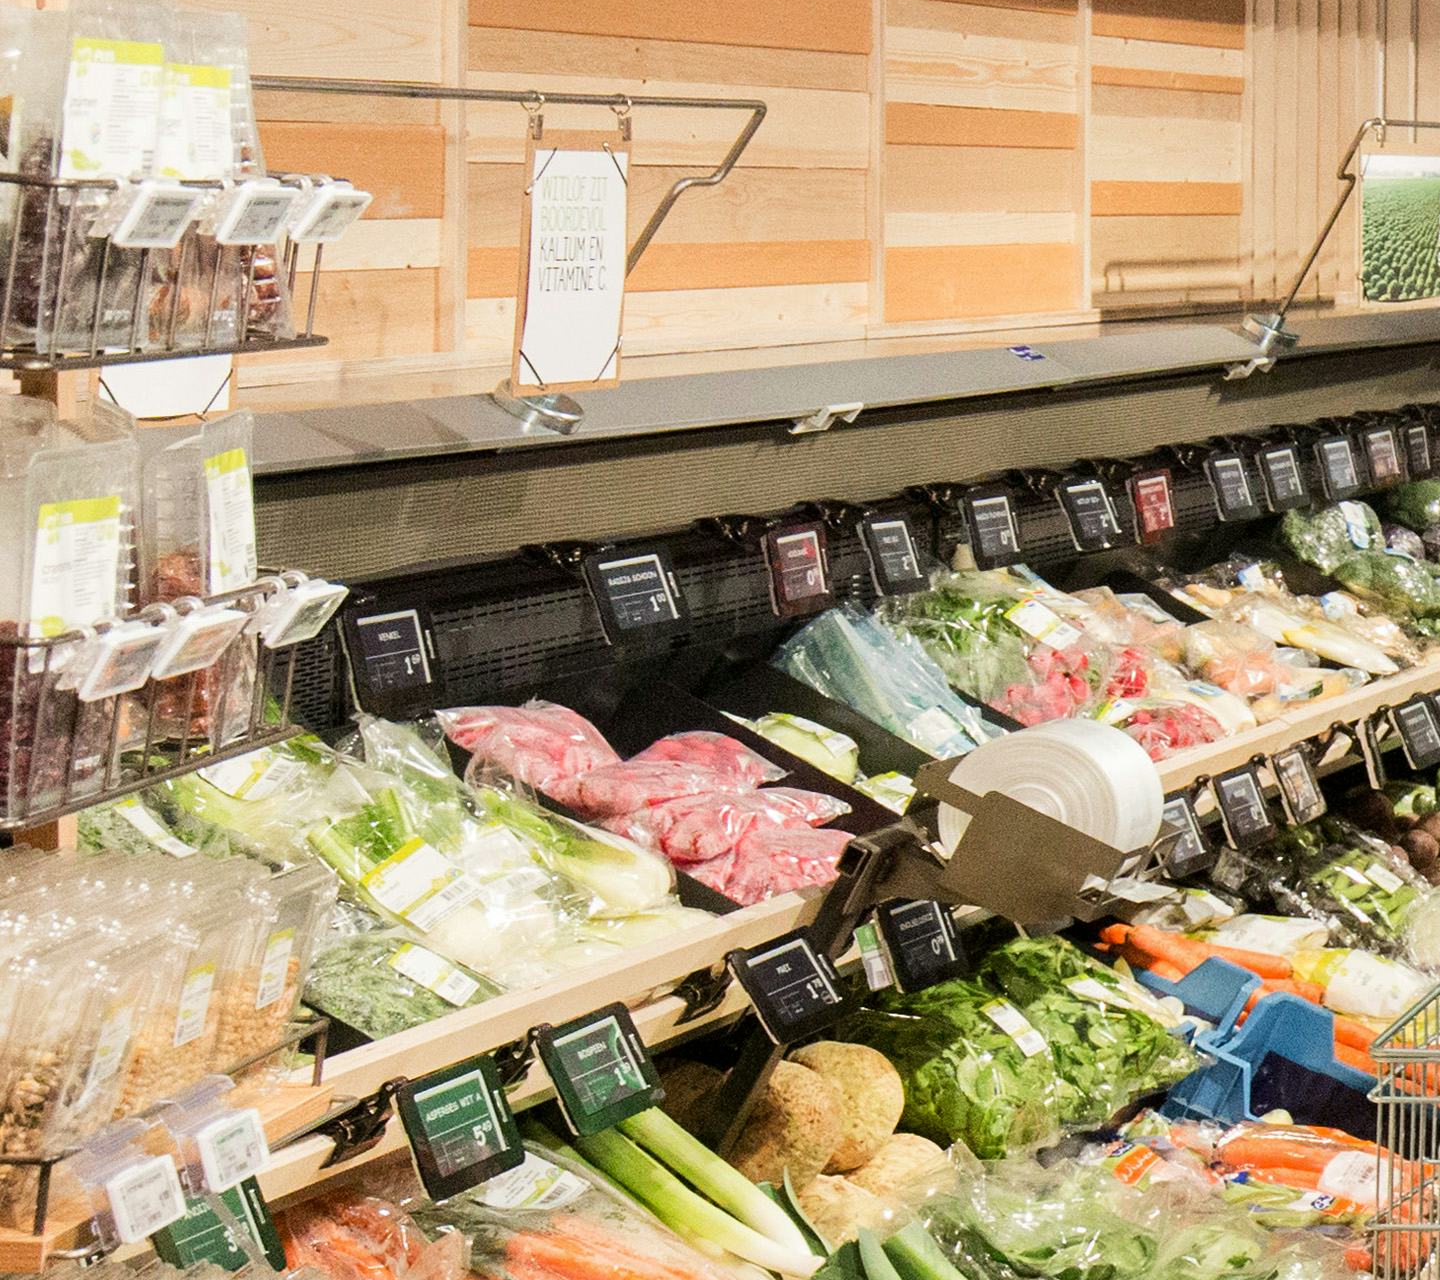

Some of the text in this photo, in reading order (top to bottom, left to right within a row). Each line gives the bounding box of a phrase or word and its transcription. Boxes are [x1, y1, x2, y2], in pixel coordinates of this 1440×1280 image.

[542, 176, 608, 201] WITLOF ZIT
[540, 207, 607, 231] BOORDEVOL
[539, 236, 605, 261] KALIUM EN
[539, 266, 595, 291] VITAMINE
[426, 1096, 476, 1121] ASPERGES WIT
